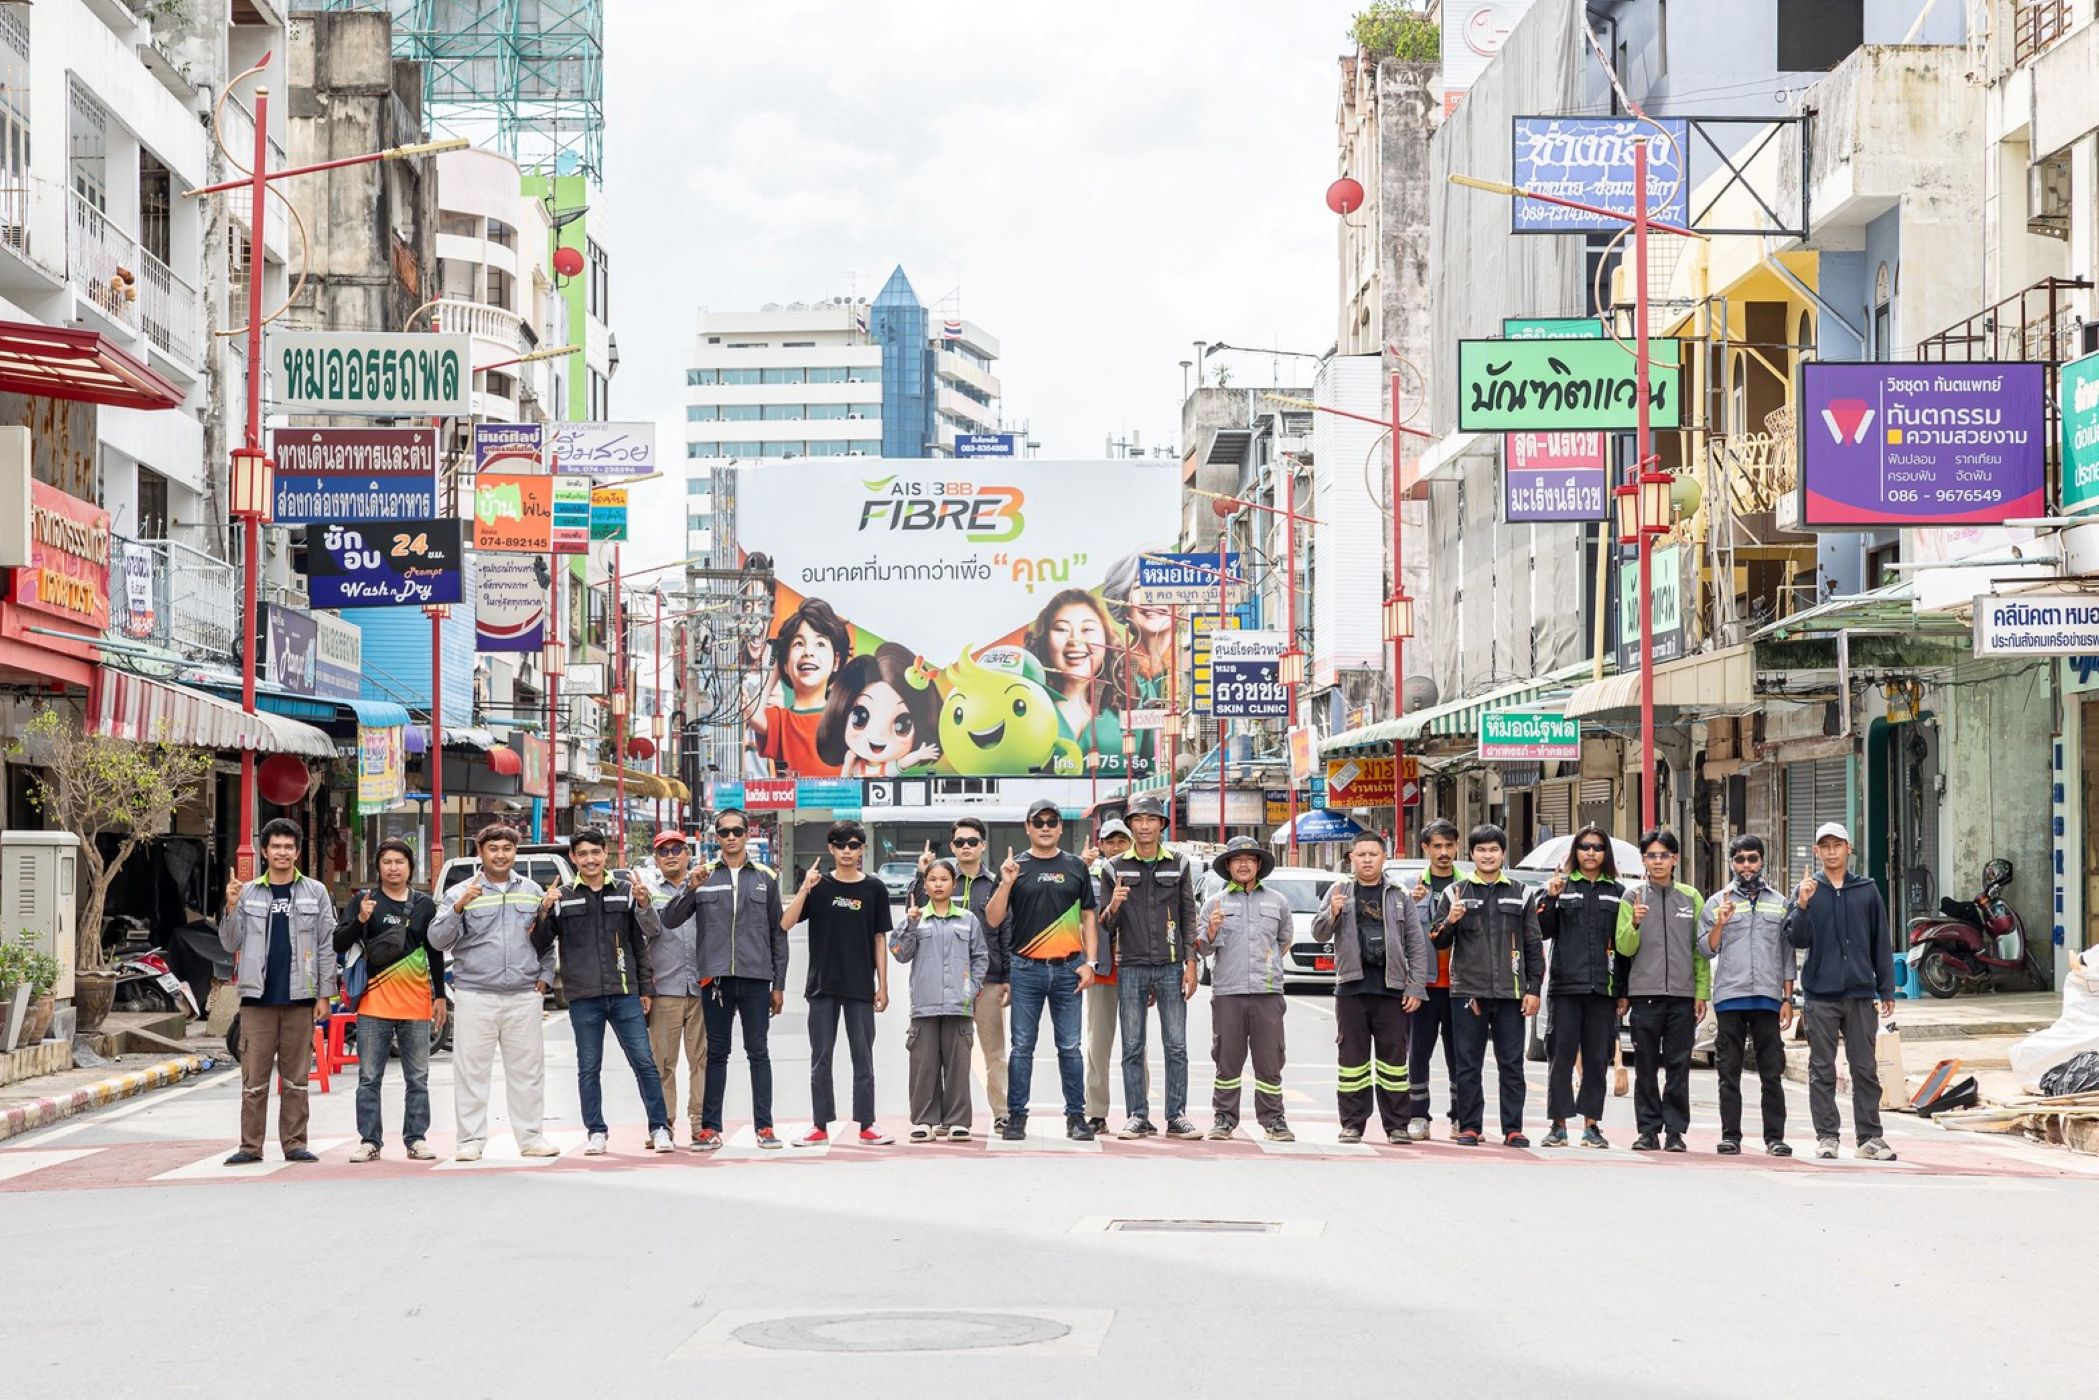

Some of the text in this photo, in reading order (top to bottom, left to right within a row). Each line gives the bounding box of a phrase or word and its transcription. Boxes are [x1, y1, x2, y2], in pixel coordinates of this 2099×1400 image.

[283, 348, 460, 401] หมออรรถพล
[1887, 375, 2004, 397] วิชชุดา ทันตแพทย์
[1887, 403, 2001, 425] ทันตกรรม
[1906, 430, 2028, 444] ความสวยงาม
[278, 433, 431, 470] ทางเดินอาหารและตับ
[1887, 453, 1936, 465] ฟันปลอม
[1955, 453, 2002, 465] รากเทียม
[1887, 470, 1936, 481] ครอบฟัน
[1955, 470, 1992, 481] จัดฟัน
[277, 478, 431, 518] ส่องกล้องทางเดินอาหาร
[891, 481, 973, 496] AIS 3BB
[1511, 477, 1601, 511] มะเร็งนรีเวช
[1888, 489, 1919, 502] 086
[1936, 489, 2002, 502] 9676549
[477, 484, 518, 519] บ้าน
[323, 525, 362, 550] ซัก
[391, 533, 445, 559] 24 ชม.
[480, 537, 548, 549] 074-892145
[343, 550, 382, 569] อบ
[801, 554, 991, 583] อนาคตที่มากกว่าเพื่อ
[404, 565, 443, 579] Prompt
[340, 581, 389, 598] Wash
[395, 580, 433, 602] Dry
[1994, 603, 2062, 627] คลีนิคตา
[1215, 665, 1237, 673] หมอ
[1216, 673, 1288, 701] ธวัชชัย
[1216, 704, 1287, 713] SKIN CLINIC
[1486, 715, 1576, 743] หมอณัฐพล
[1082, 755, 1119, 769] 175
